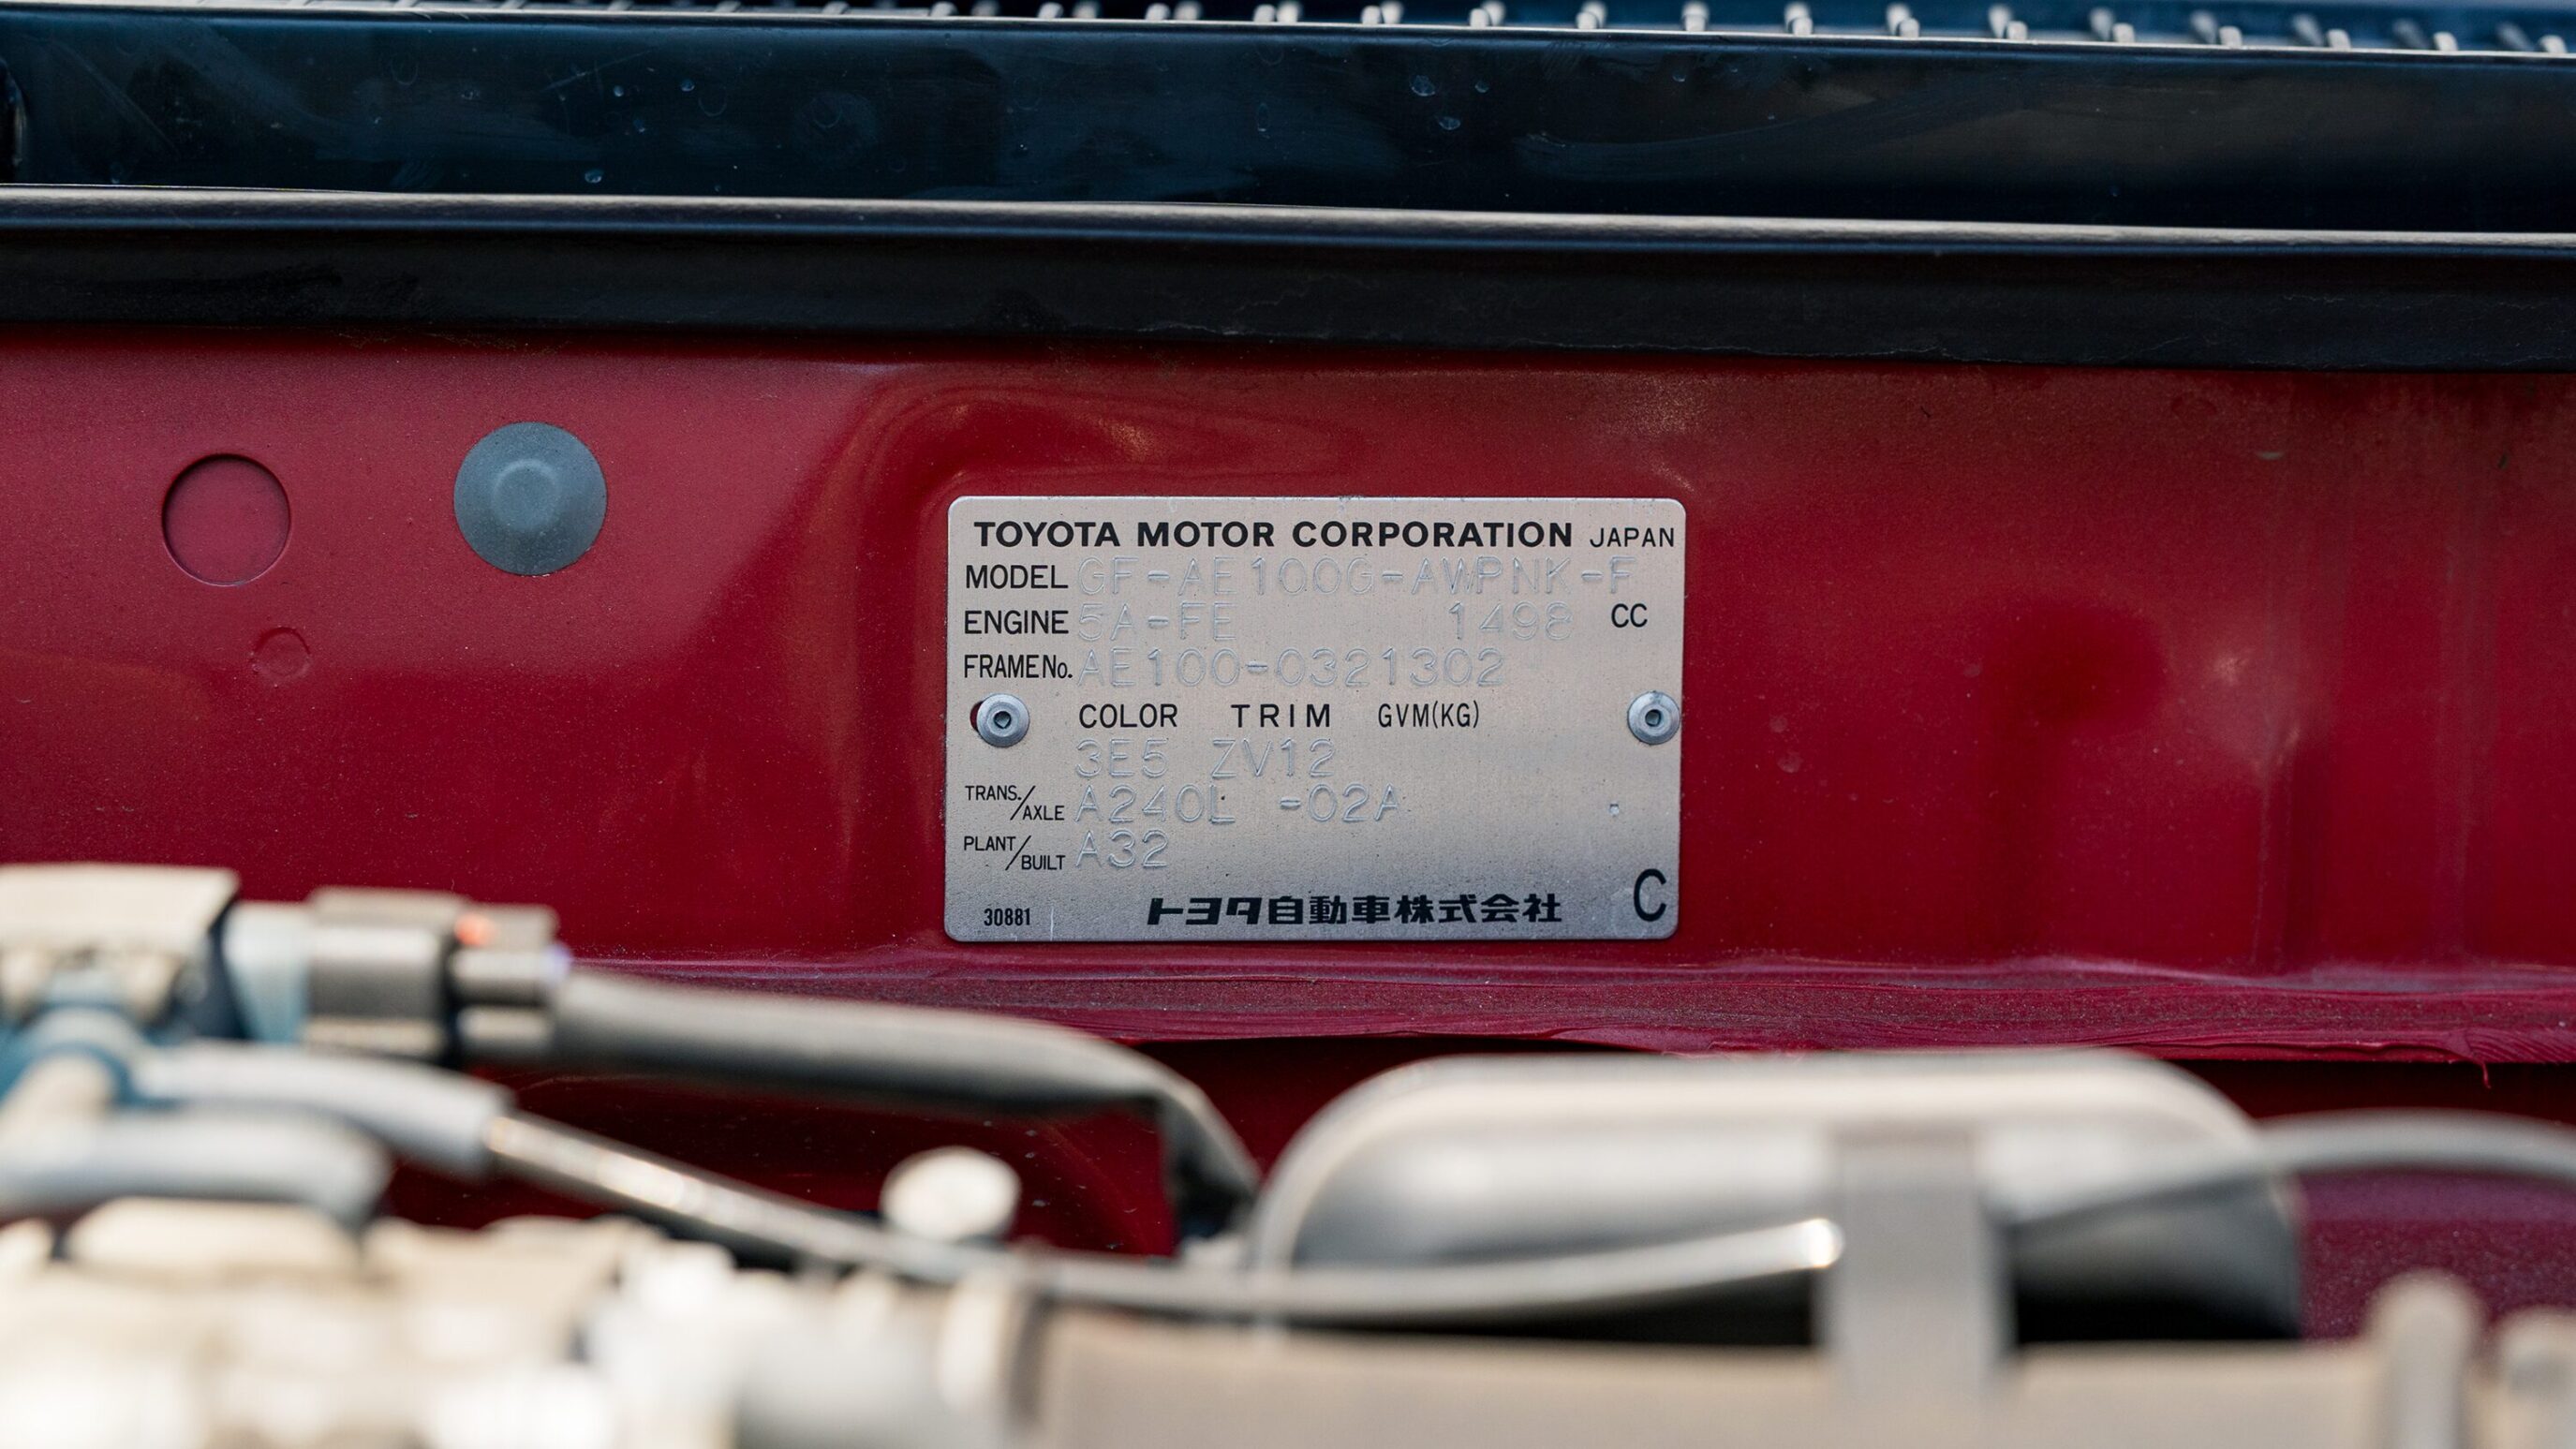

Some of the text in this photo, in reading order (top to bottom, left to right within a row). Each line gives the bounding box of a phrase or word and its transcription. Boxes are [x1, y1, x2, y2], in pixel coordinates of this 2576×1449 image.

[973, 521, 1675, 548] TOYOTA MOTOR CORPORATION JAPAN
[965, 564, 1069, 589] MODEL
[964, 600, 1649, 642] ENGINE 5A-FE 1498 CC
[1077, 646, 1504, 688] AE100-0321302
[1078, 702, 1480, 730] COLOR TRIM GVM(KG)
[1075, 737, 1337, 777] 3E5 ZV12
[1075, 782, 1400, 824] A240L -02A
[1074, 828, 1169, 868] A32
[1147, 893, 1562, 925] トヨタ自動車株式会社
[1633, 868, 1667, 923] C
[984, 908, 1031, 926] 30881
